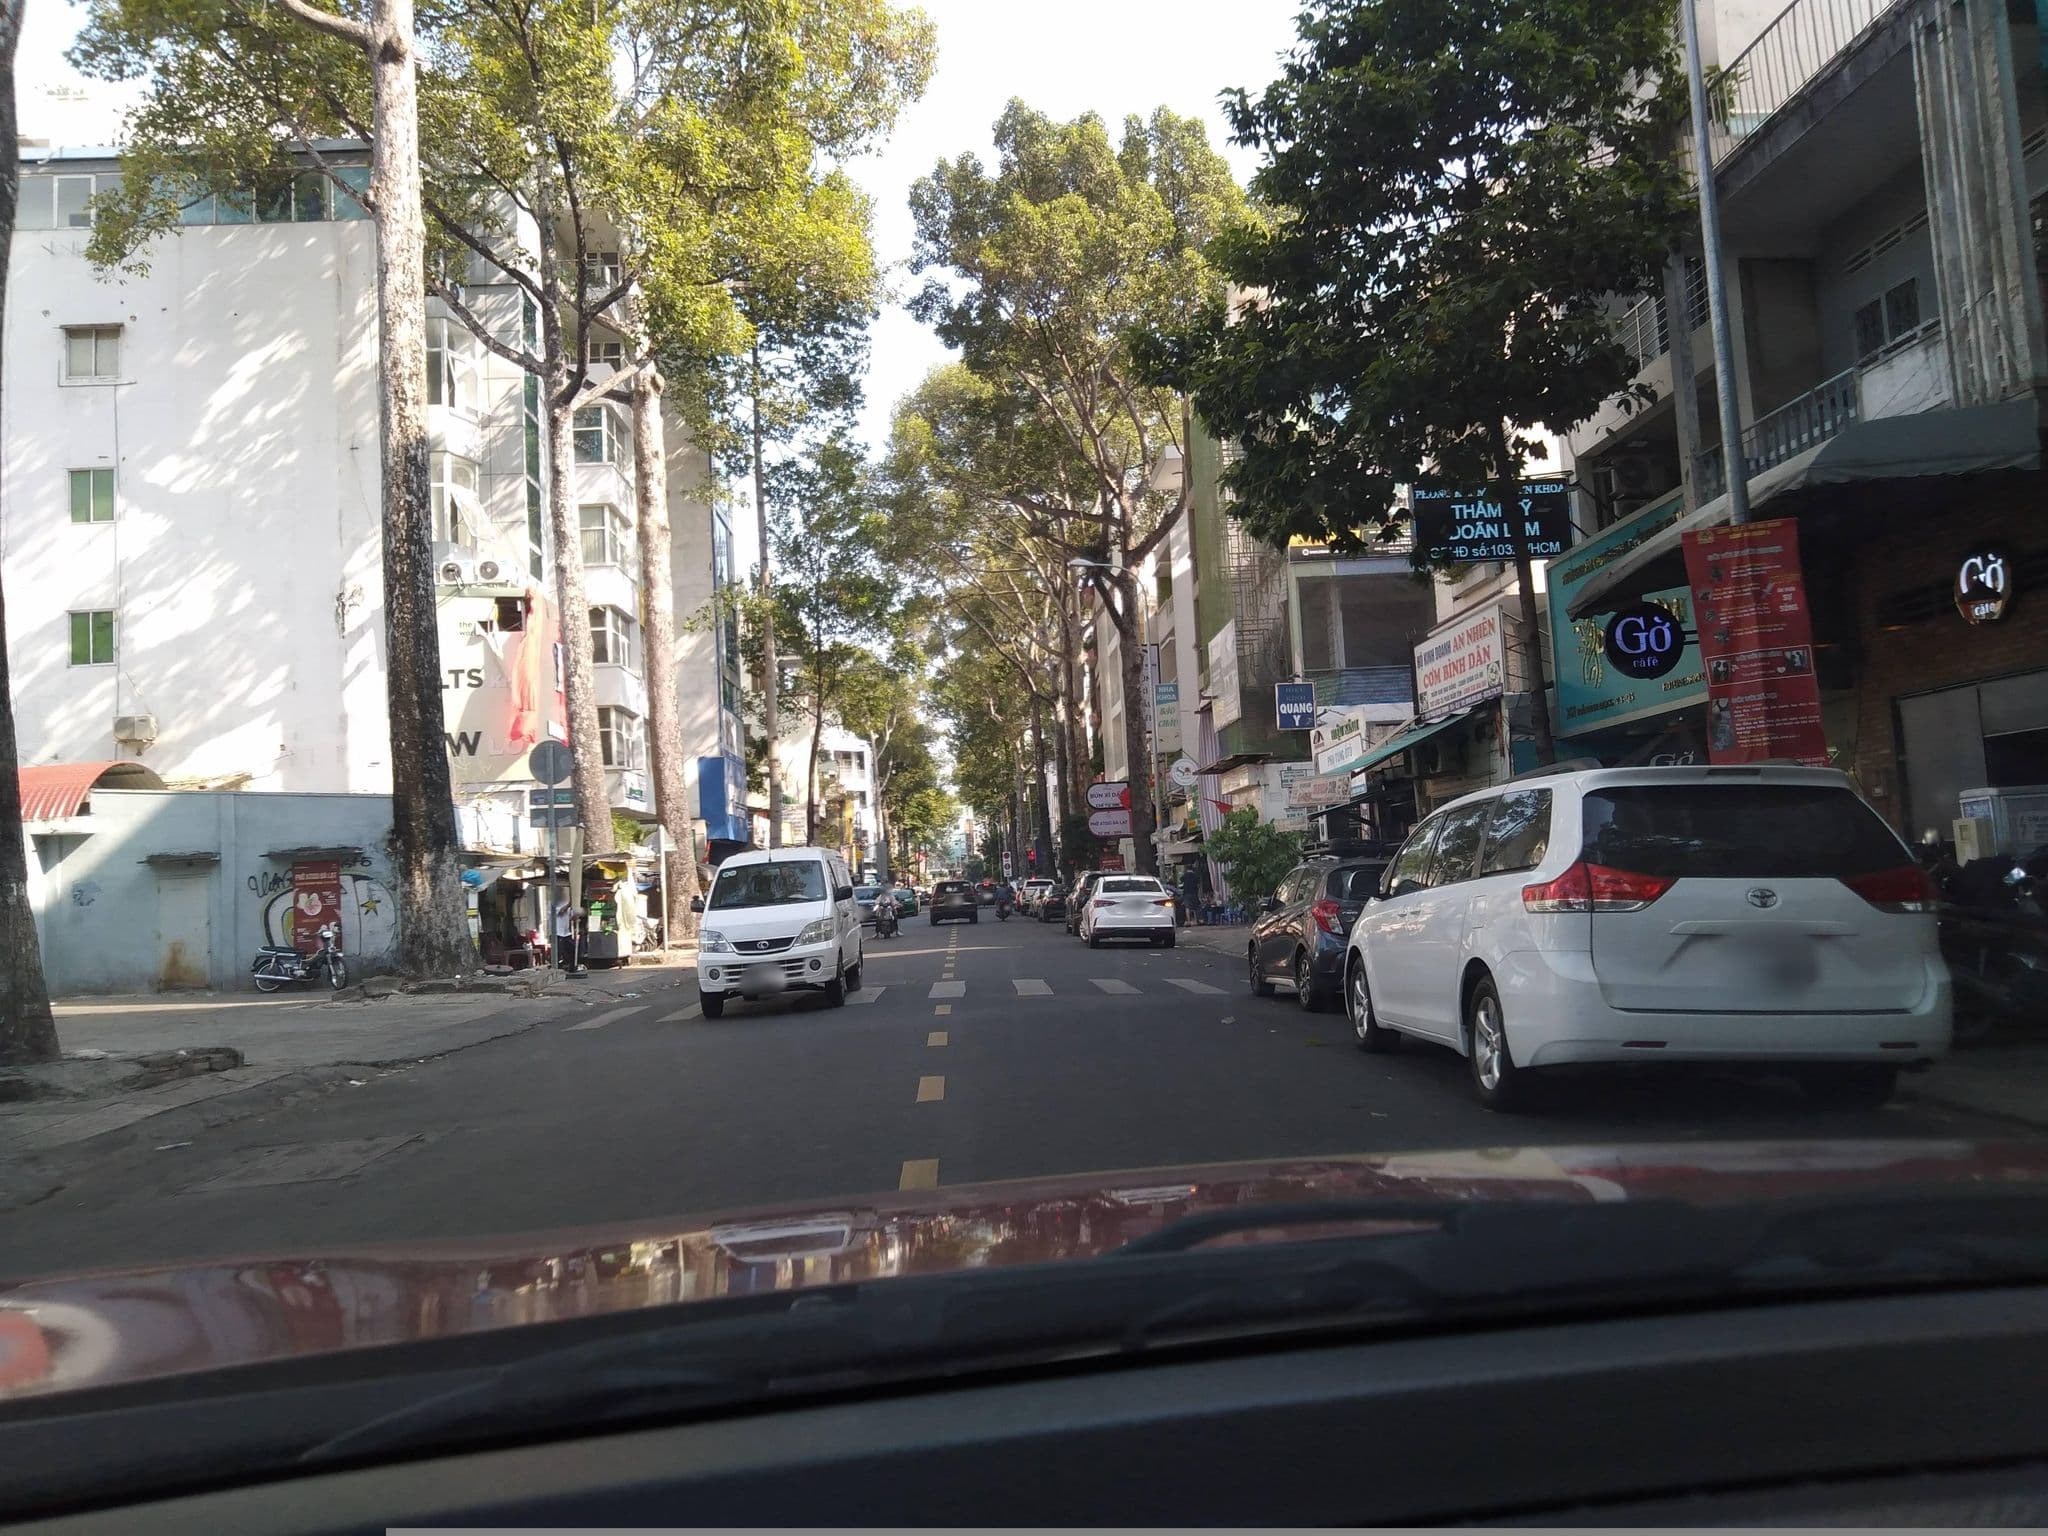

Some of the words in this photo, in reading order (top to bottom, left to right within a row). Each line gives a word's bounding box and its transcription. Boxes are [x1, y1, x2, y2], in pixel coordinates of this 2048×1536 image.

[1535, 484, 1564, 494] KHOA
[1504, 521, 1540, 537] LM
[1453, 633, 1466, 653] AN
[1615, 616, 1672, 654] Gờ
[1423, 665, 1441, 689] CƠM
[1442, 657, 1466, 681] BÌNH
[1468, 644, 1491, 669] DÂN
[1280, 703, 1313, 714] QUANG
[1293, 715, 1301, 727] Y
